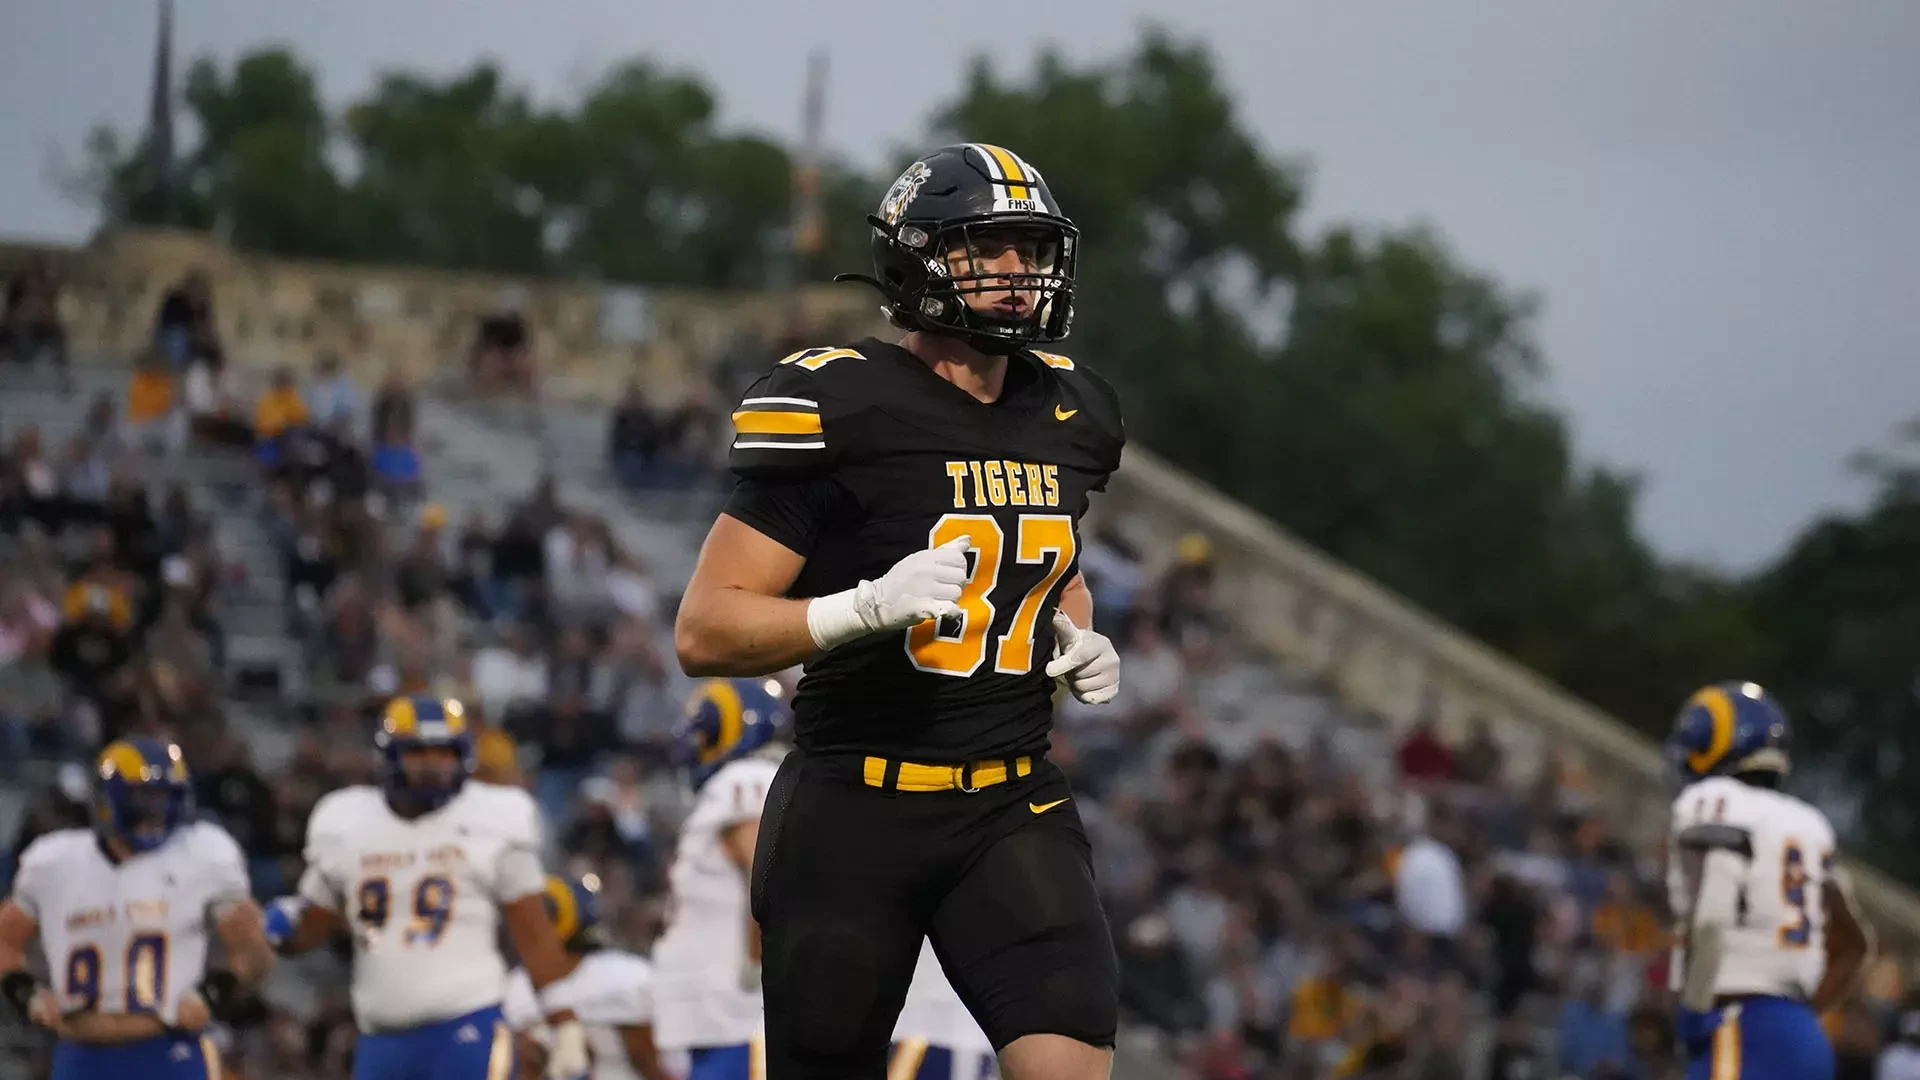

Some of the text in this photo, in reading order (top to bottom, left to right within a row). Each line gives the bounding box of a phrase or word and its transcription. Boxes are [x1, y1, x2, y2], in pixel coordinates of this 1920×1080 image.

[1008, 199, 1036, 211] FHSU
[946, 460, 1060, 508] TIGERS
[904, 513, 1076, 677] 87
